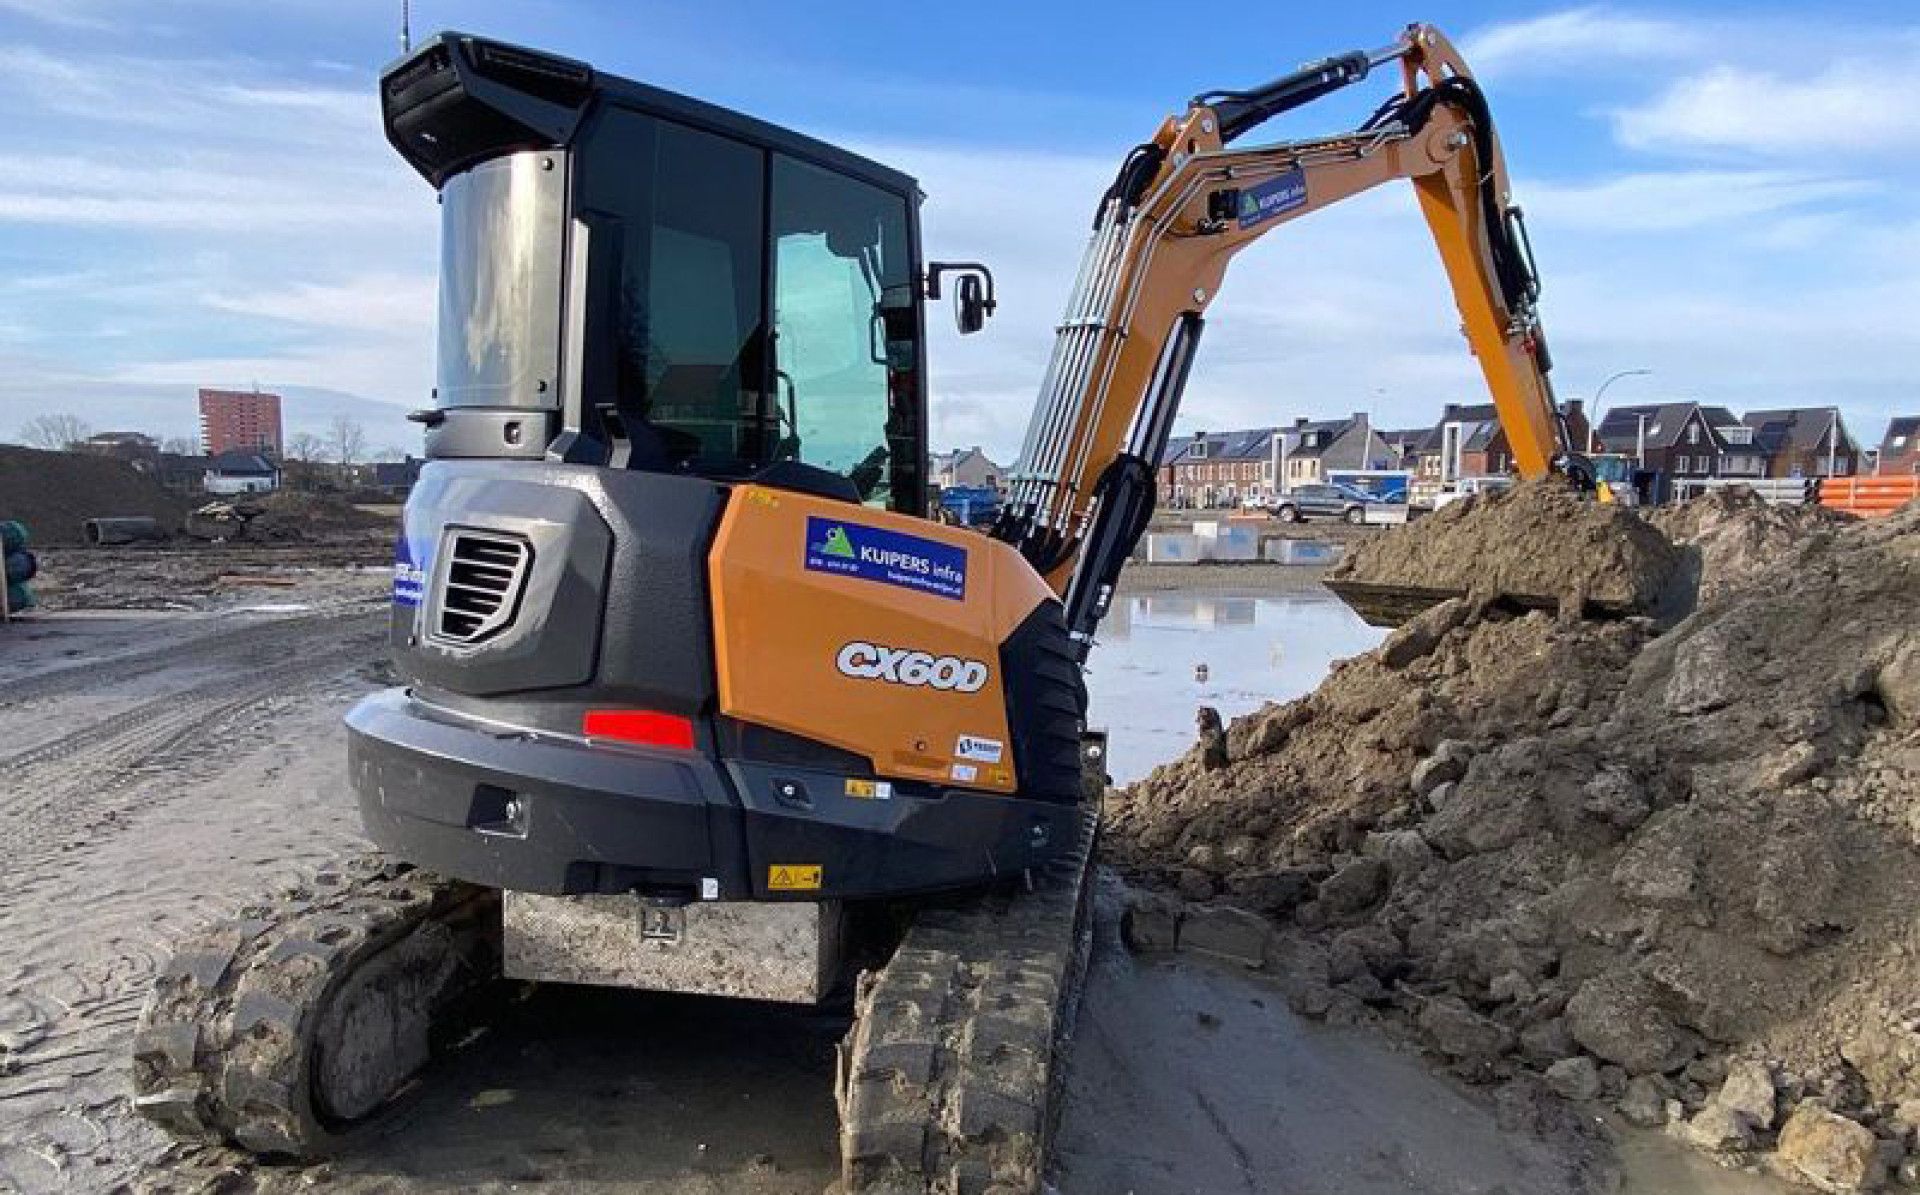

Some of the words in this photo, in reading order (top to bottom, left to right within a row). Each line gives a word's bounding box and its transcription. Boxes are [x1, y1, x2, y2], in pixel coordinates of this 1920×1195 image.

[861, 546, 930, 574] KUIPERS
[933, 562, 963, 583] infra
[836, 640, 988, 692] CX60D
